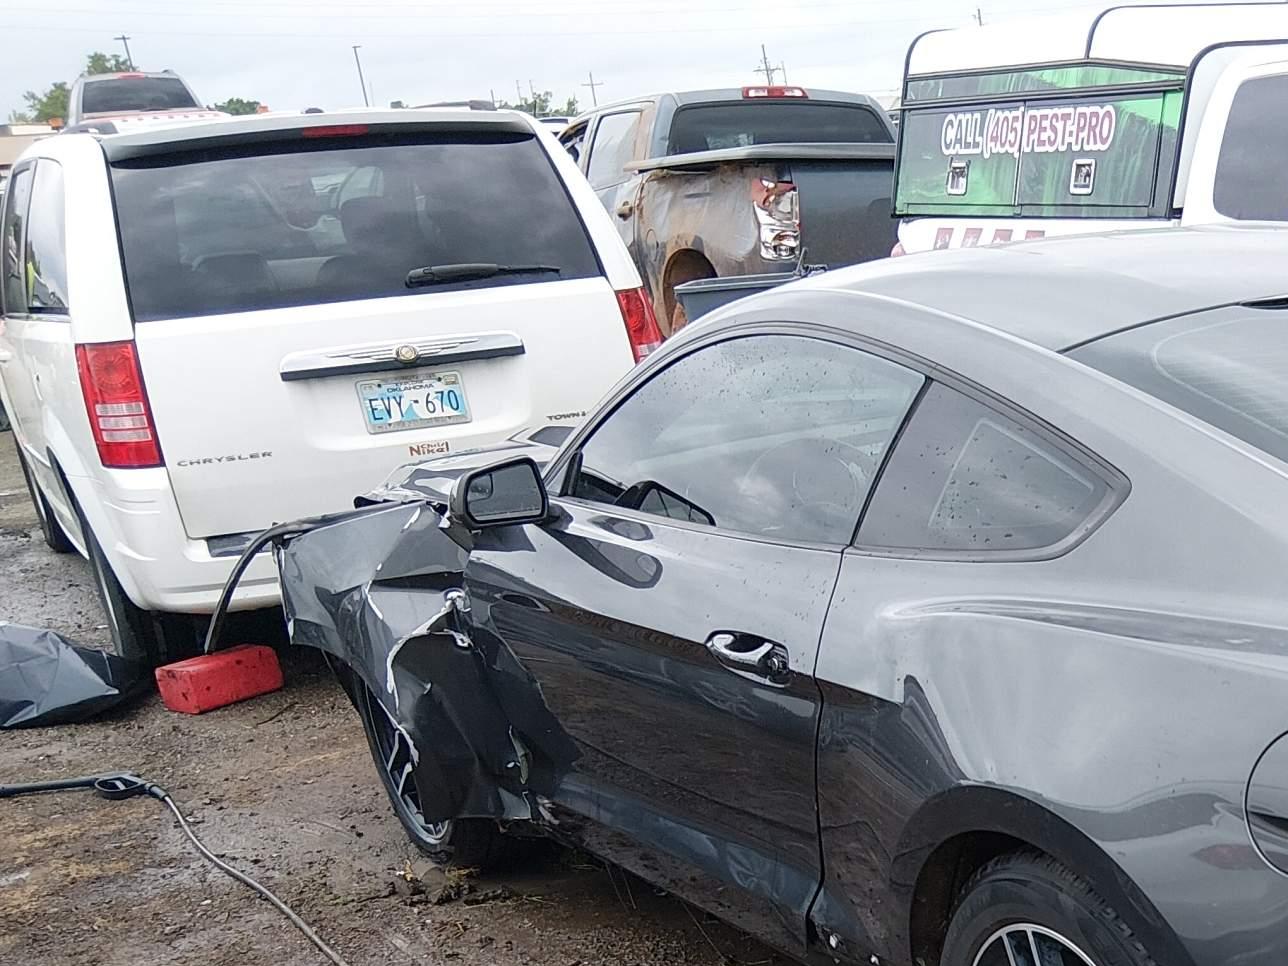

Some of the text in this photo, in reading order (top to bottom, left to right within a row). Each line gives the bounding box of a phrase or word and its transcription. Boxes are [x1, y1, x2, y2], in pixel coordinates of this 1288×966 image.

[942, 113, 982, 154] CALL
[1025, 106, 1115, 151] PEST-PRO
[386, 383, 434, 393] OKLAHOMA
[546, 412, 580, 421] TOWN
[177, 451, 273, 467] CHRYSLER
